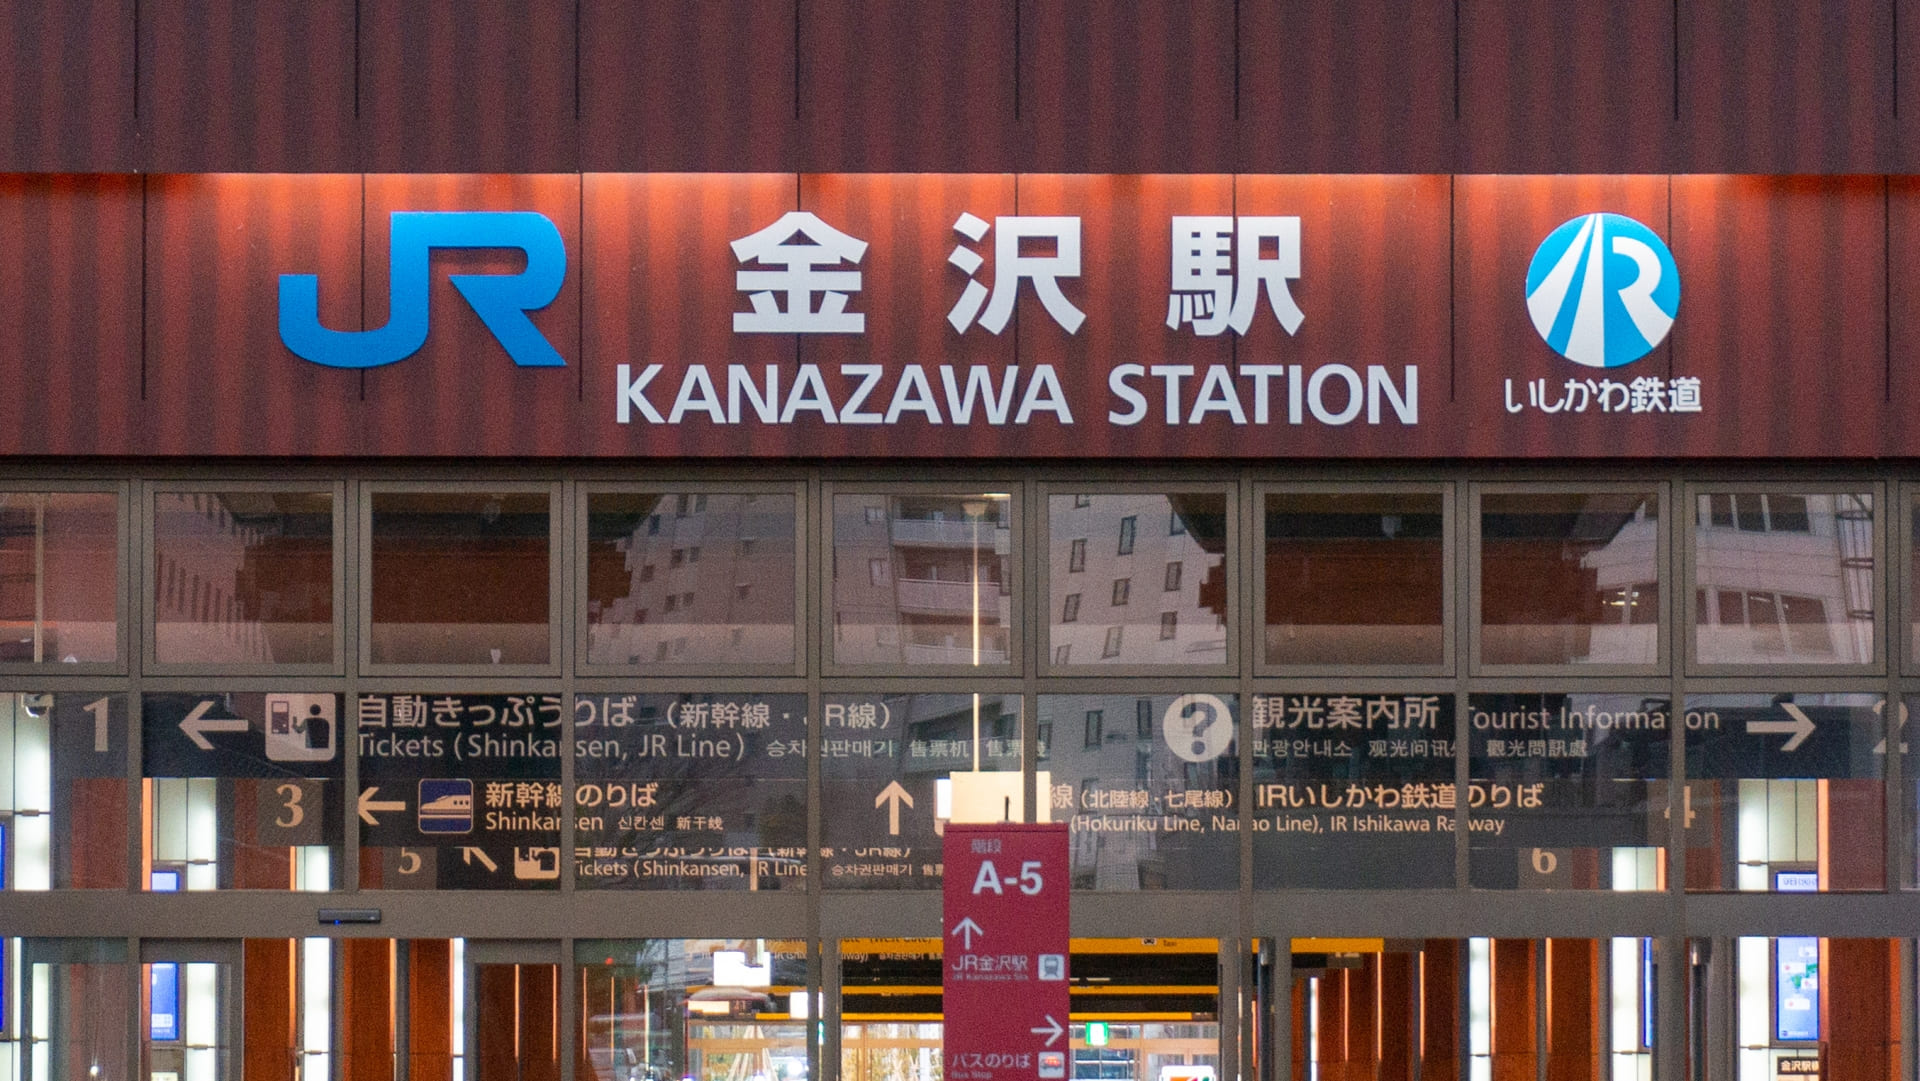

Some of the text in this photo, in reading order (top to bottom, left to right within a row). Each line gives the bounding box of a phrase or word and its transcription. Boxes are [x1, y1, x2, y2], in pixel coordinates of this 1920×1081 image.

[278, 211, 567, 368] JR
[730, 211, 1305, 336] 金沢駅
[616, 363, 1418, 426] KANAZAWA STATION
[1504, 376, 1702, 413] いしかわ鉄道
[83, 697, 109, 752] 1
[1252, 695, 1440, 729] 観光案内所
[1561, 704, 1719, 729] Informaon
[454, 732, 627, 761] (Shinkasen,
[638, 733, 667, 757] JR
[275, 784, 304, 828] 3
[1330, 815, 1347, 832] IR
[1353, 814, 1430, 832] Ishikawa
[1436, 815, 1505, 836] Raway
[972, 860, 1043, 895] A-5
[952, 954, 1028, 971] JR金沢駅
[952, 1053, 1032, 1068] バスのりば
